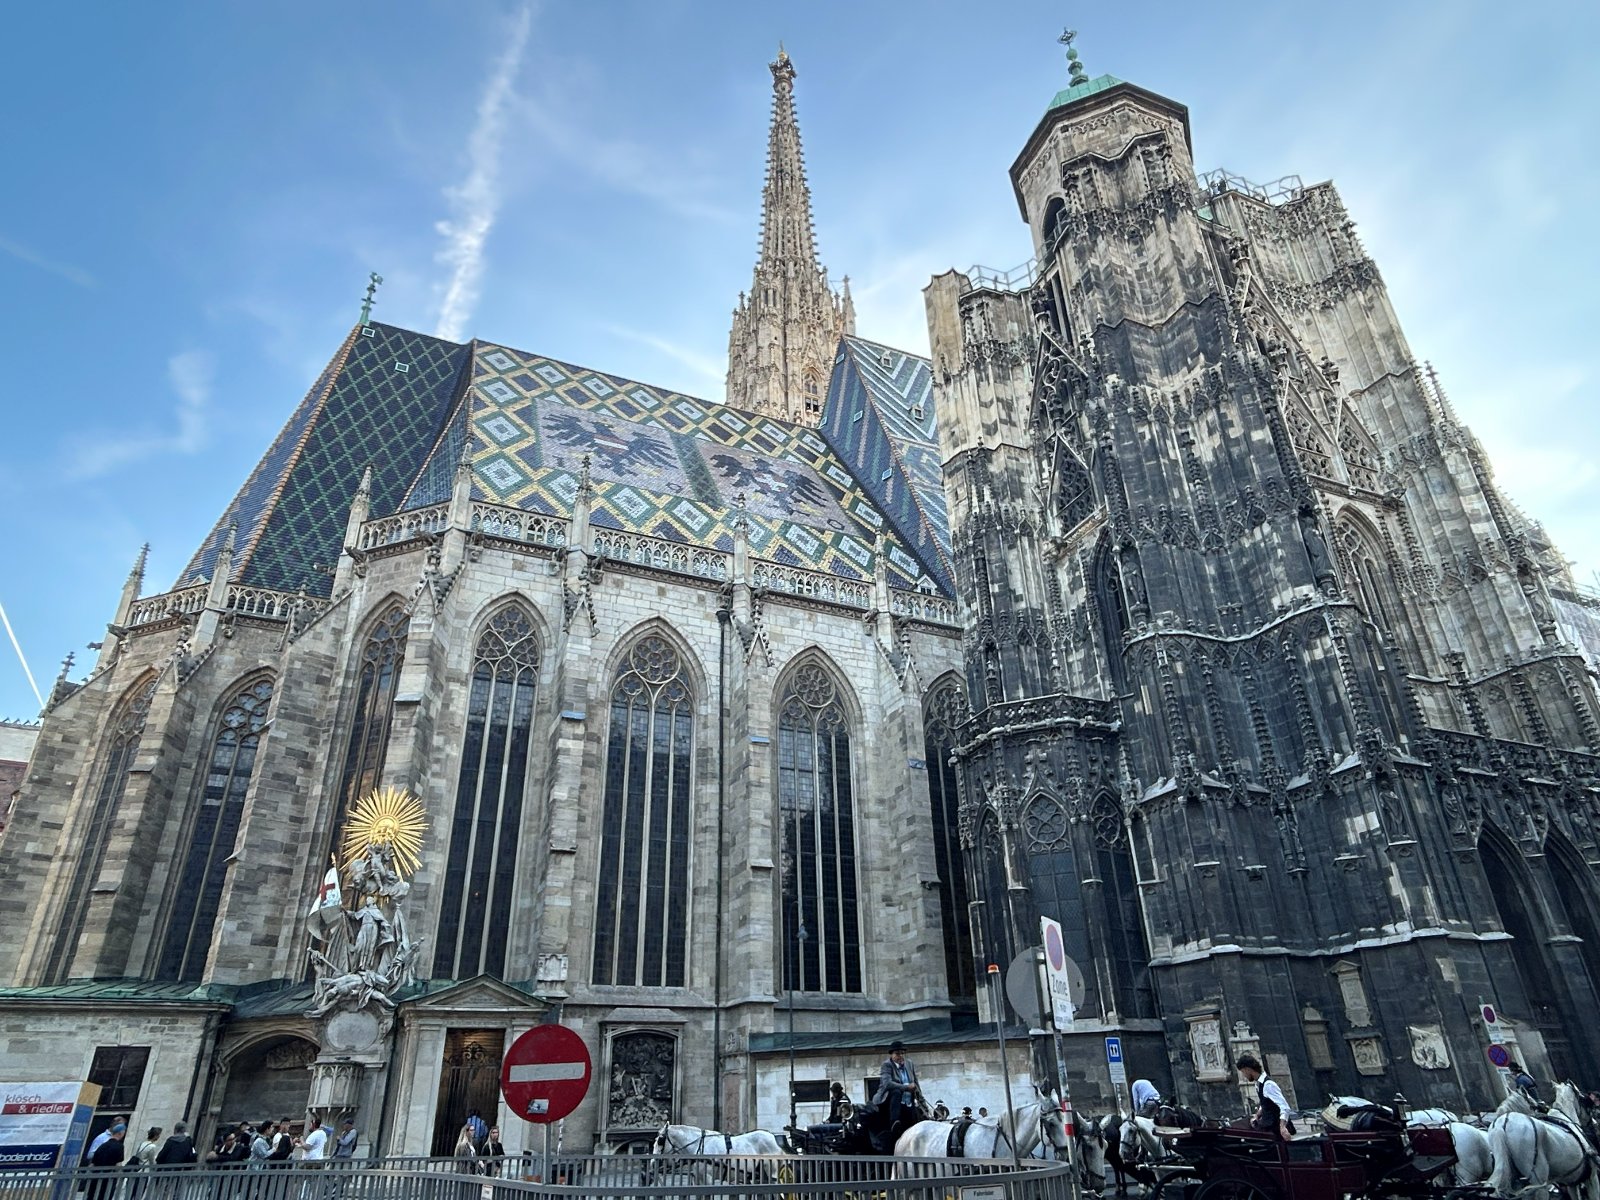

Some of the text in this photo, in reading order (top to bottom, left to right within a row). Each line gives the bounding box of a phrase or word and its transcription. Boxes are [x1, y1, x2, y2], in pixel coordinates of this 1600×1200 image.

[1051, 974, 1068, 996] Zone
[18, 1104, 69, 1114] & riedler
